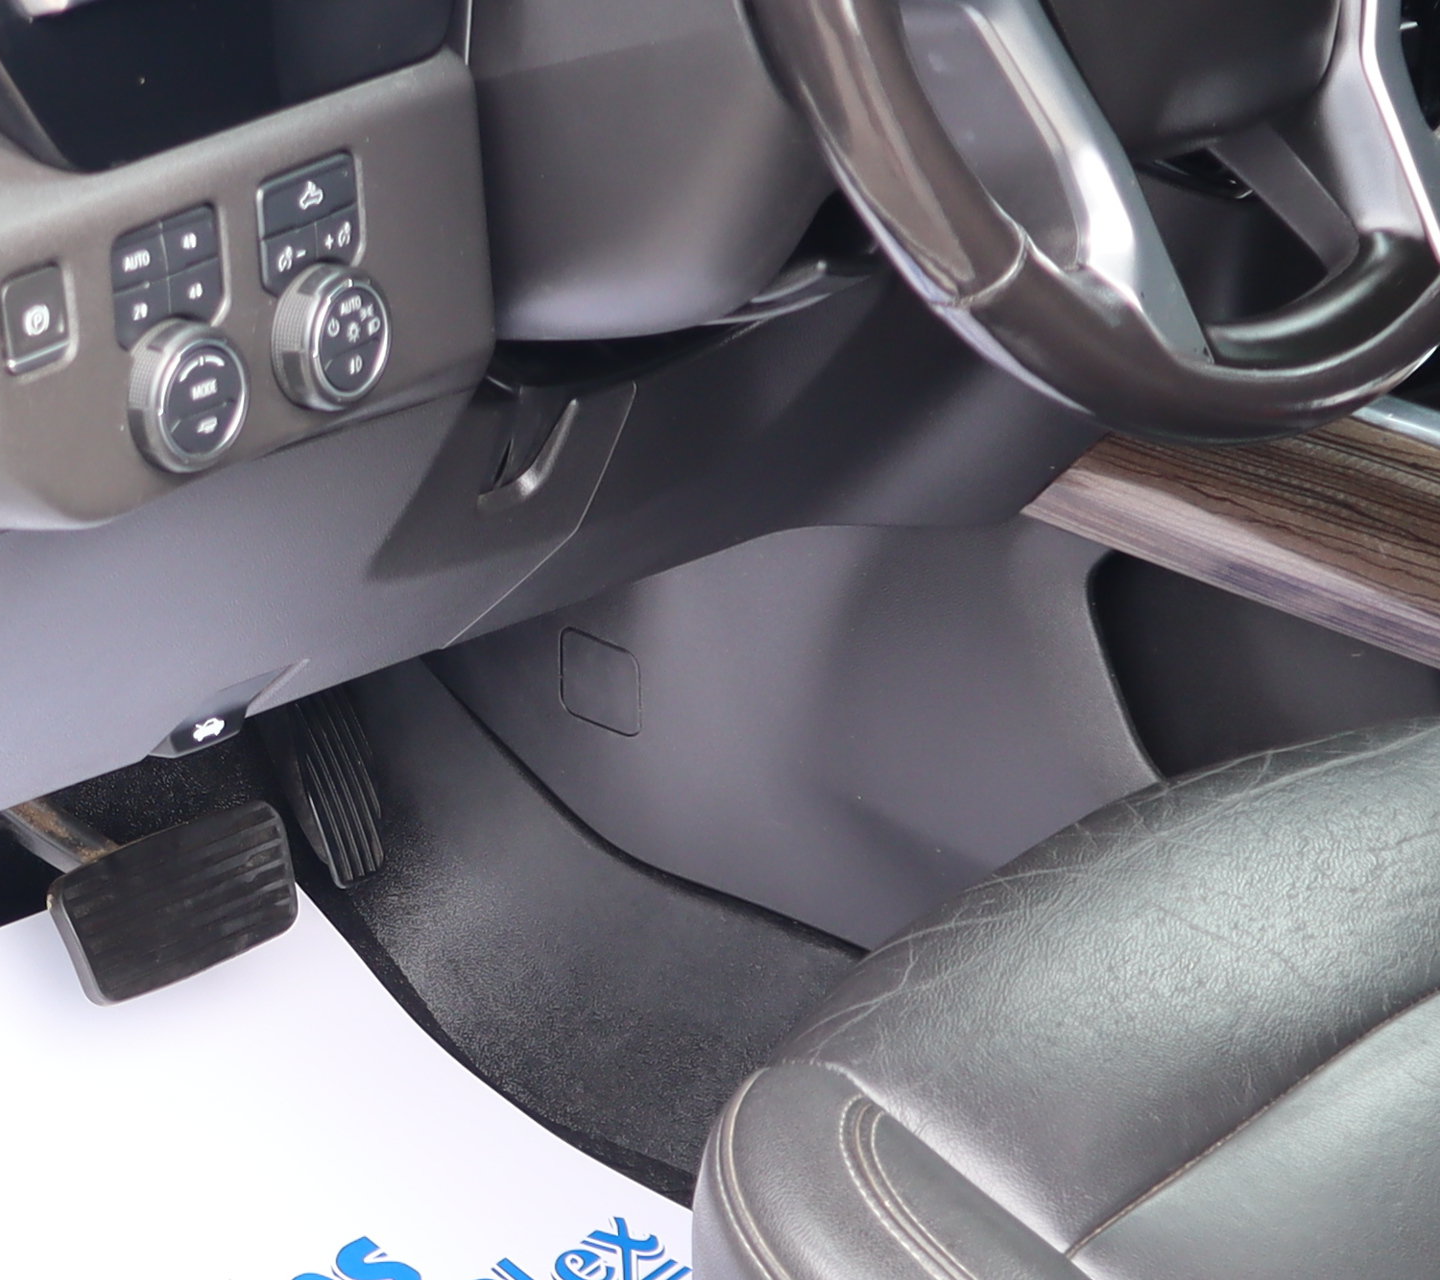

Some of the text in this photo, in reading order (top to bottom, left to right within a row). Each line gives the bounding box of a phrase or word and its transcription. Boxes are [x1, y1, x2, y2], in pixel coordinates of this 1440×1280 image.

[122, 249, 151, 272] AUTO
[340, 294, 362, 317] AUTO
[190, 377, 218, 401] MODE
